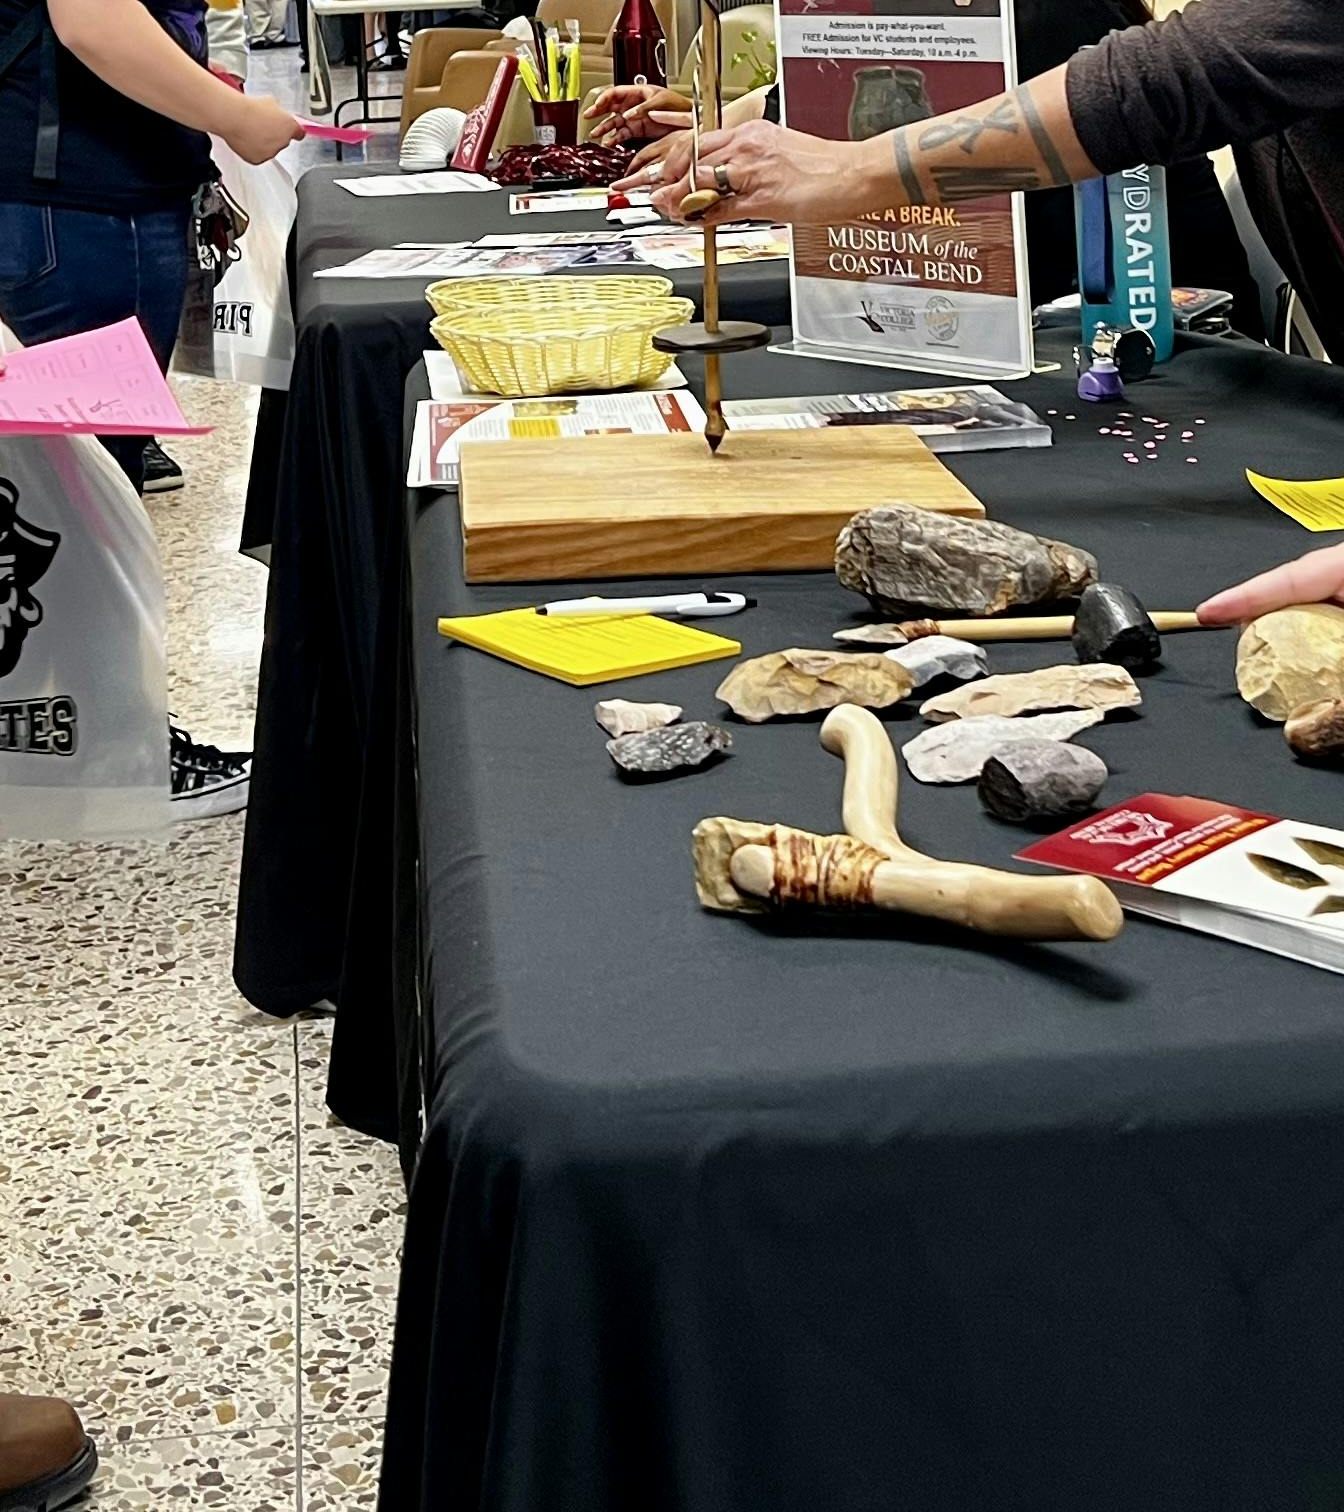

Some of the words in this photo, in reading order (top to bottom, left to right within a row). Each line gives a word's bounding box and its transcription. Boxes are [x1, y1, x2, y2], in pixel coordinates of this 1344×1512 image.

[829, 21, 866, 30] Admission
[802, 33, 822, 42] FREE
[823, 33, 860, 42] Admission
[873, 34, 884, 43] VC
[885, 34, 917, 44] students
[919, 35, 933, 44] and
[802, 46, 828, 56] Viewing
[884, 208, 896, 222] A
[900, 206, 961, 227] BREAK.
[827, 226, 930, 255] MUSEUM
[934, 240, 953, 261] of
[953, 240, 978, 259] the
[1122, 163, 1157, 331] YDRATED
[828, 253, 920, 279] COASTAL
[924, 260, 983, 284] BEND
